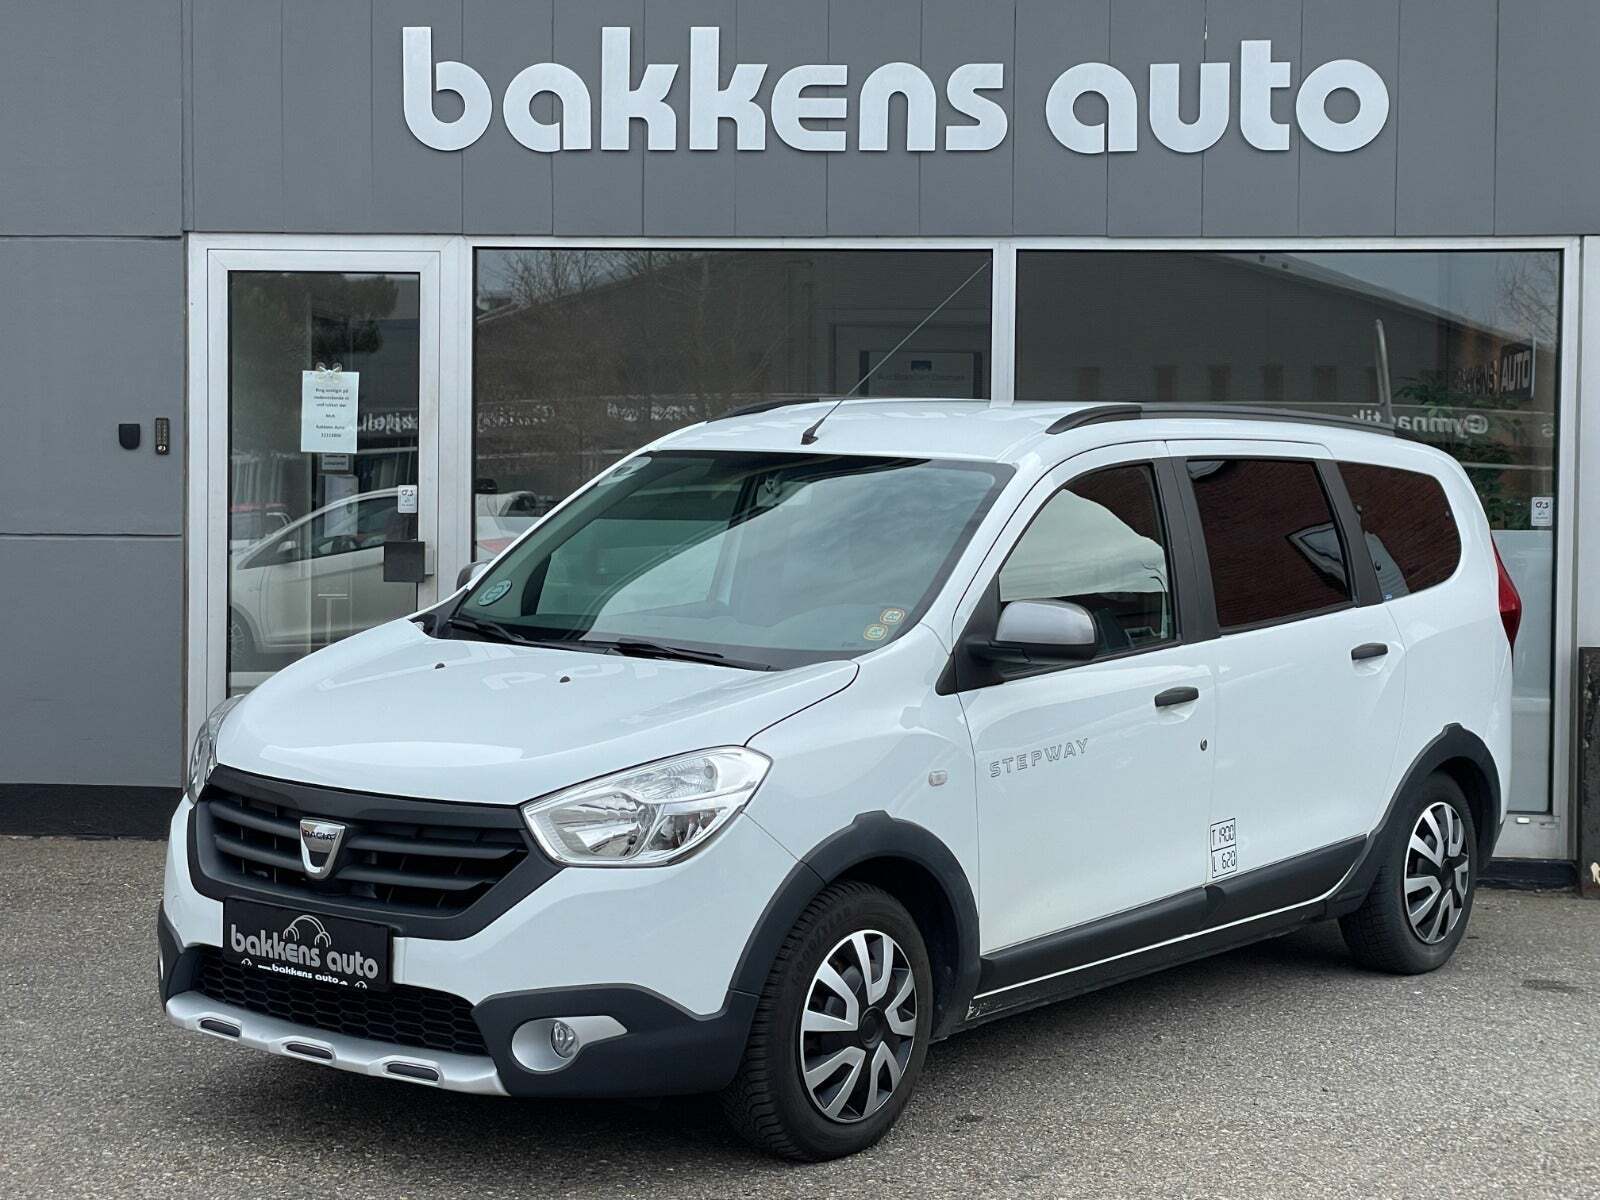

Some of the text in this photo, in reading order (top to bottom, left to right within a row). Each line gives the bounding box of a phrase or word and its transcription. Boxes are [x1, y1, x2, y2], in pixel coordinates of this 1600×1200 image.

[403, 26, 1390, 154] bakkens auto
[1501, 350, 1530, 393] AUTO
[989, 737, 1088, 778] STEPWAY
[1219, 824, 1234, 843] 1900
[1222, 850, 1236, 869] 620
[231, 923, 378, 979] bakkens auto
